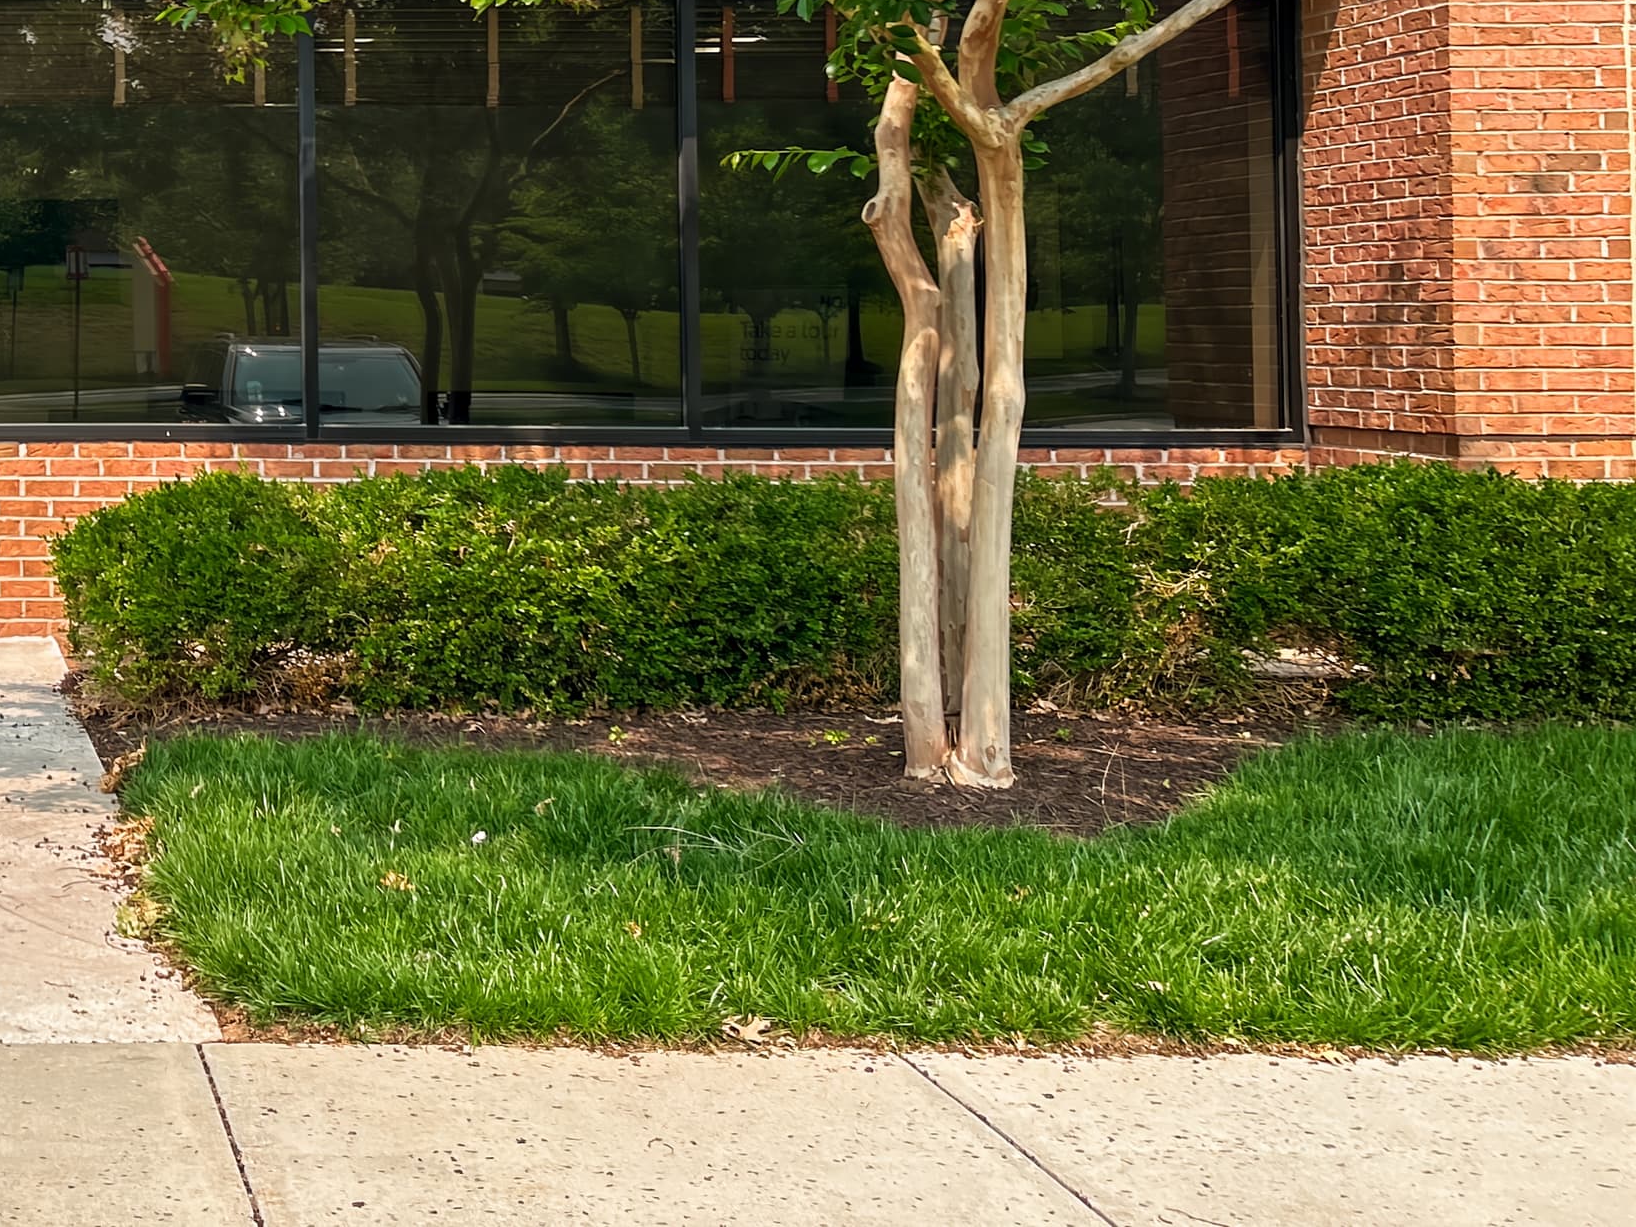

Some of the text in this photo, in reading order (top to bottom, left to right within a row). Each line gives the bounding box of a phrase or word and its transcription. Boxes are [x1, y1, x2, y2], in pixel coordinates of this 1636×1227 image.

[740, 321, 839, 339] Take a tour
[740, 344, 789, 365] today
